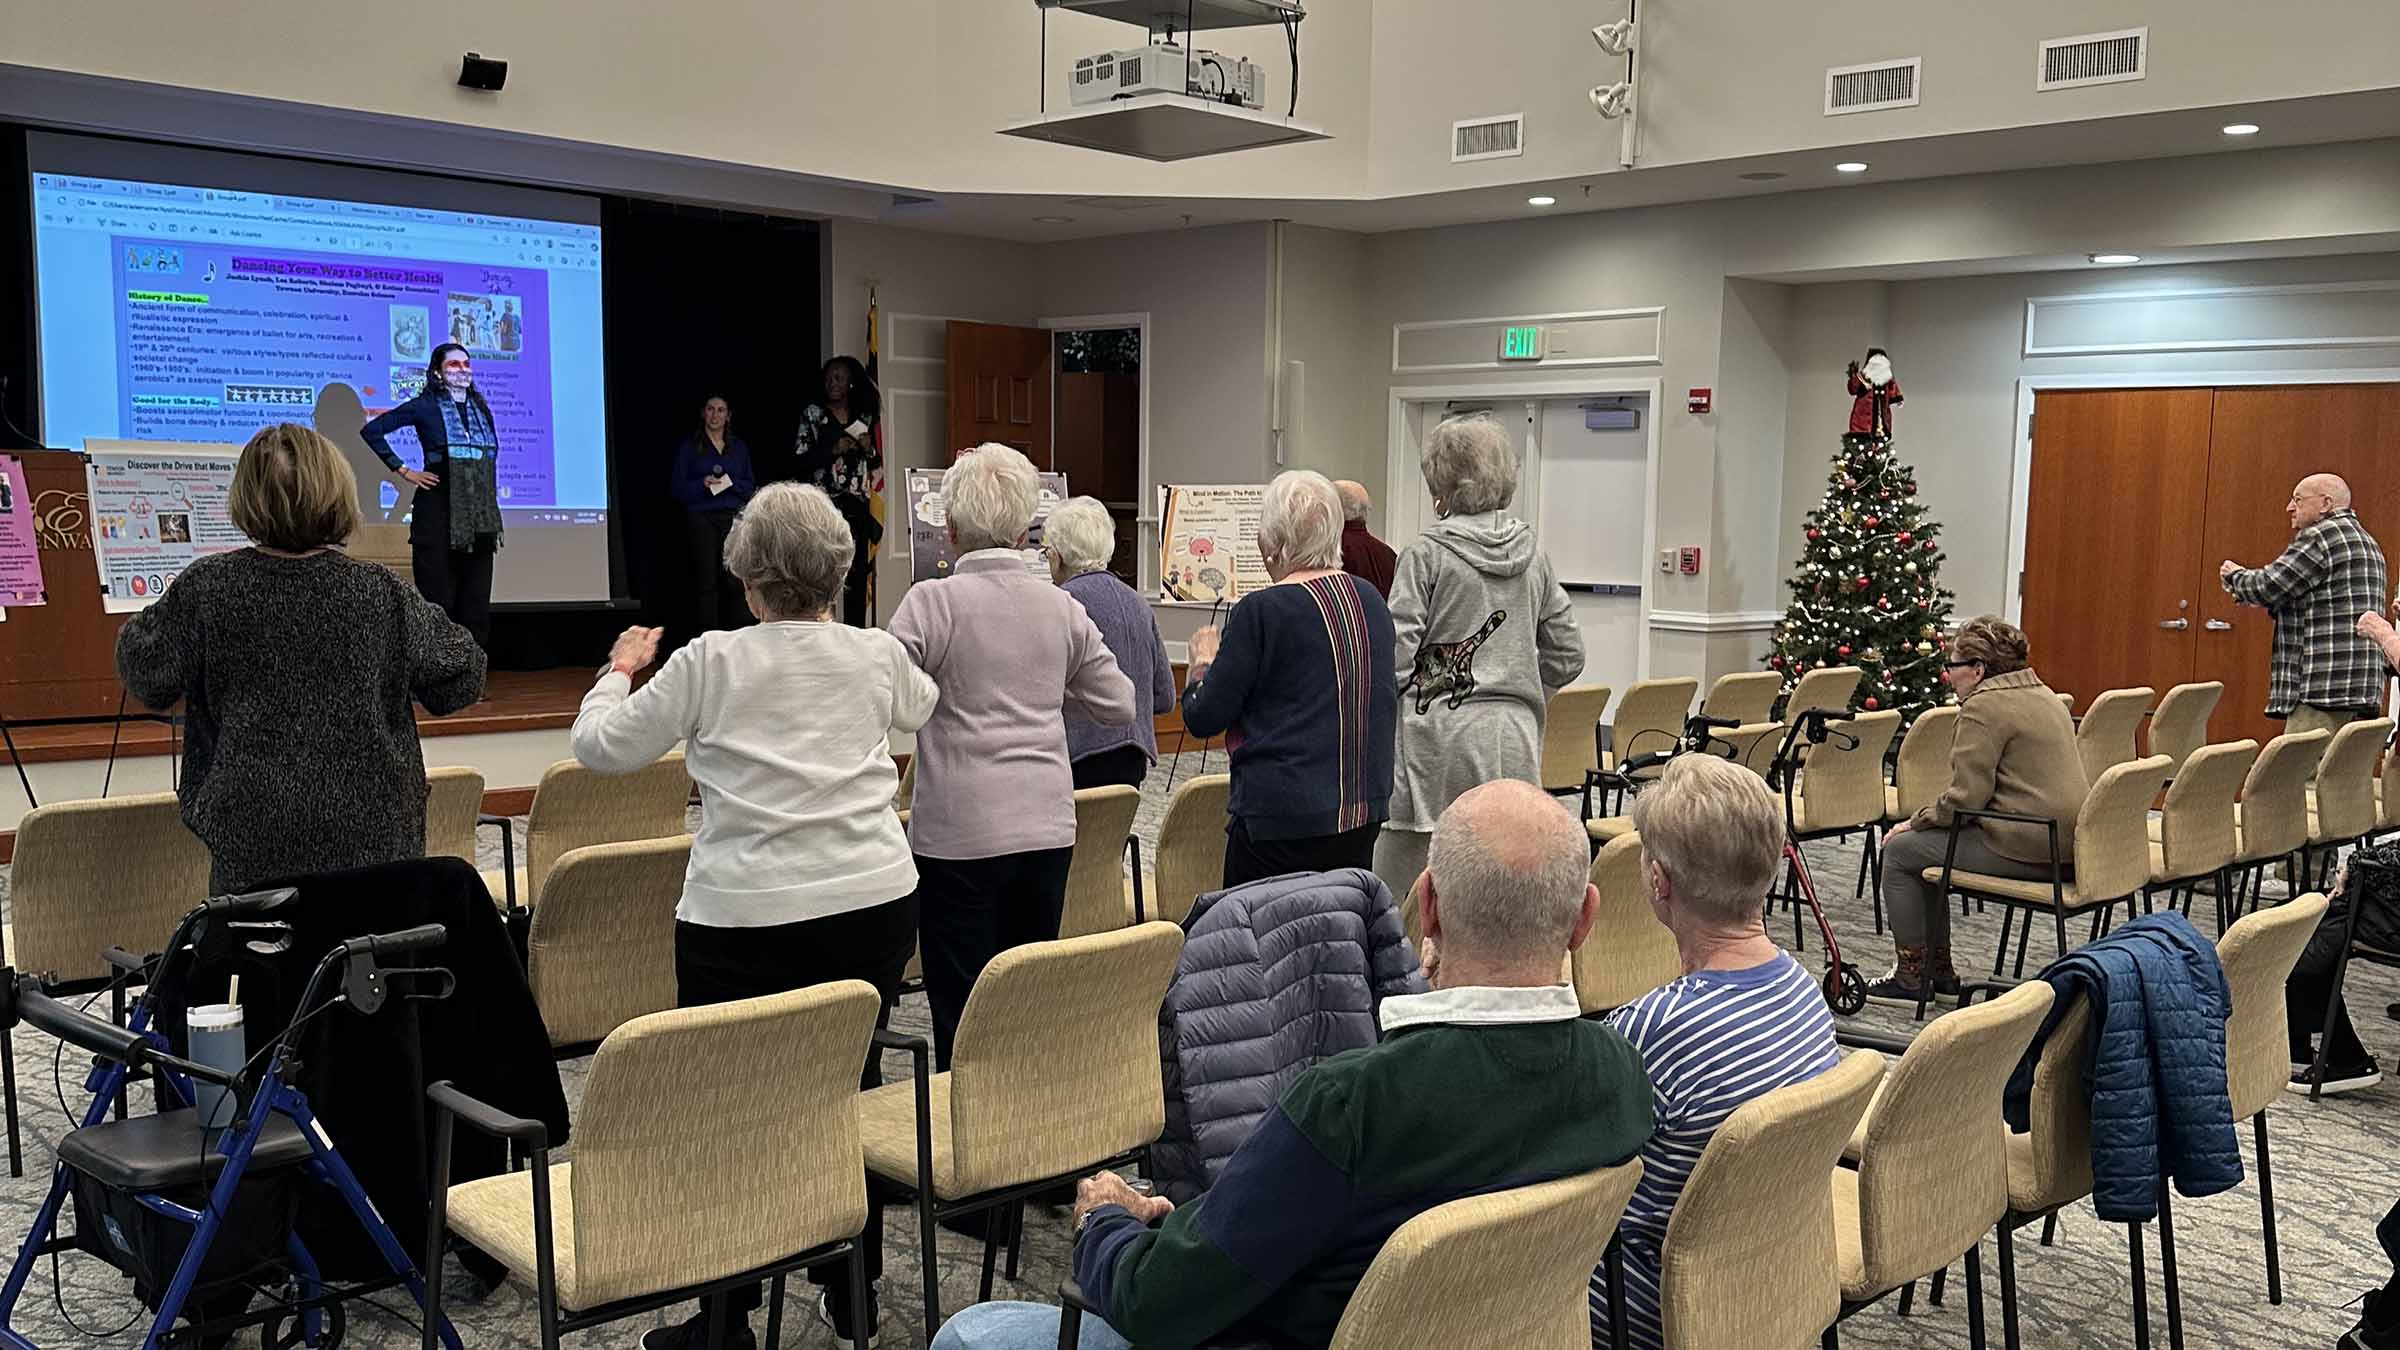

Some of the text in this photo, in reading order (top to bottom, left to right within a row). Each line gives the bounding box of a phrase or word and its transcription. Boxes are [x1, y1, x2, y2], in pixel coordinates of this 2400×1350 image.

[232, 258, 284, 274] Dancing
[287, 262, 317, 274] Your
[319, 263, 346, 278] Way
[349, 267, 362, 278] to
[403, 270, 443, 285] Health
[128, 292, 161, 302] History
[132, 302, 162, 311] Ancient
[164, 304, 185, 312] form
[172, 316, 218, 325] expression
[132, 323, 186, 333] Renaissance
[206, 328, 249, 338] emergence
[262, 329, 283, 338] ballet
[316, 333, 355, 341] recreation
[132, 334, 190, 343] entertainment
[1506, 327, 1536, 357] EXIT
[133, 355, 198, 365] societal change
[221, 349, 250, 357] various
[301, 352, 334, 360] reflected
[335, 353, 365, 361] cultural
[196, 366, 231, 375] initiation
[241, 368, 264, 376] boom
[275, 370, 314, 380] popularity
[188, 377, 222, 385] exercise
[132, 397, 156, 405] Good
[157, 397, 172, 405] for
[136, 405, 164, 415] Boosts
[223, 408, 256, 417] function
[136, 416, 163, 425] Builds
[165, 417, 185, 425] bone
[187, 418, 218, 428] density
[228, 420, 259, 428] reduces
[136, 425, 152, 434] risk
[127, 460, 161, 470] Discover
[161, 461, 173, 470] the
[174, 461, 194, 471] Drive
[194, 462, 208, 471] that
[209, 462, 231, 472] Moves
